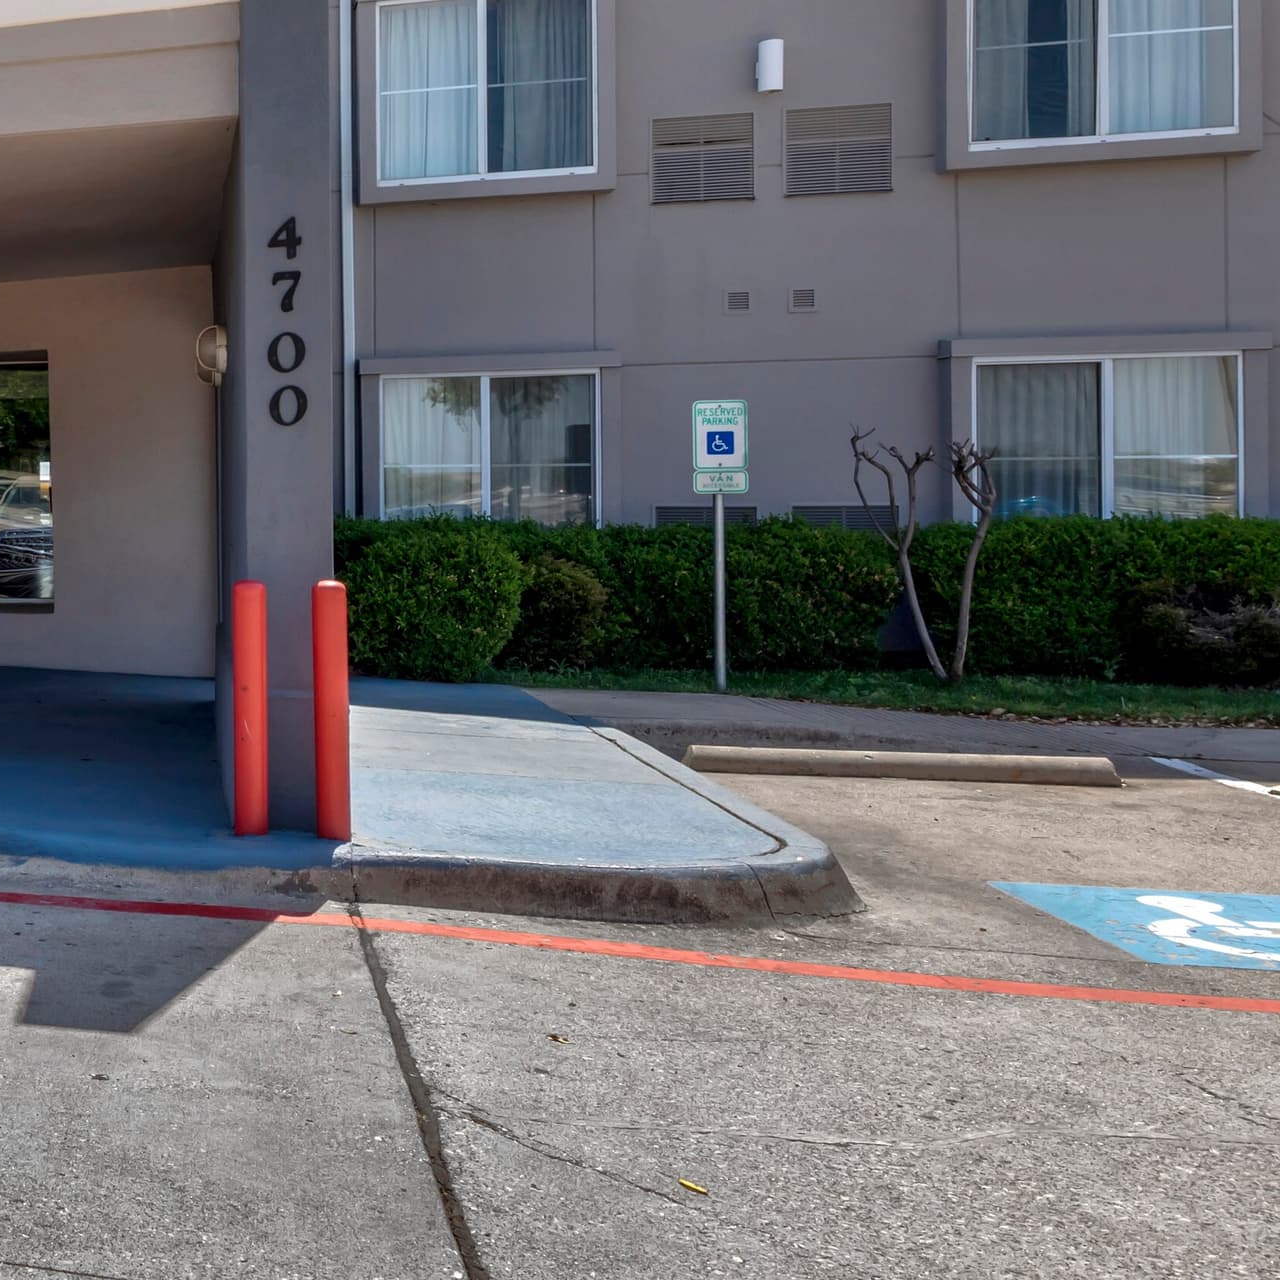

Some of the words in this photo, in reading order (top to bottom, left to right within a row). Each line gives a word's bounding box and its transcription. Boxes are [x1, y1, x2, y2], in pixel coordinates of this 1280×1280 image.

[267, 216, 308, 426] 4700
[697, 407, 744, 417] RESERVED
[702, 416, 739, 426] PARKING
